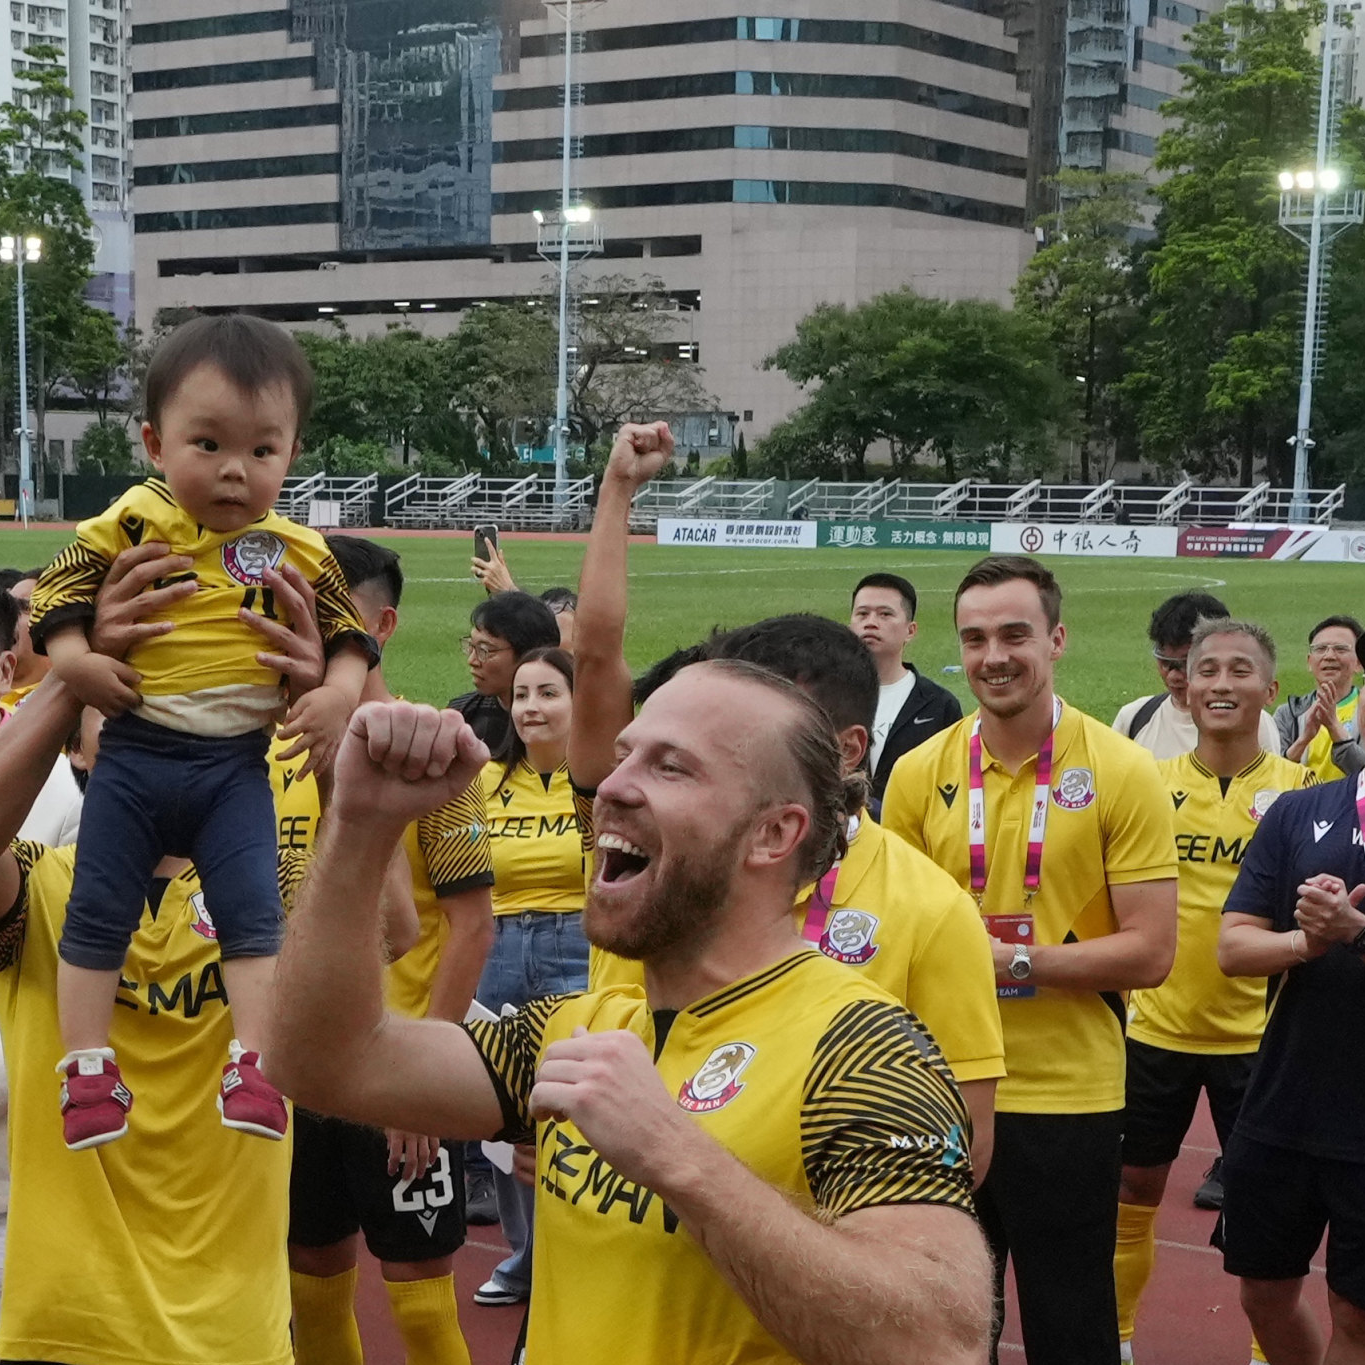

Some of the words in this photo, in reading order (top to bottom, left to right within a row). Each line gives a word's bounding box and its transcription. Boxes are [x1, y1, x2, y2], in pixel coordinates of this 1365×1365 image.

[673, 526, 716, 543] ATACAR
[725, 536, 800, 545] www.atacar.com.hk
[827, 525, 878, 547] 運動家
[226, 562, 242, 579] LEE
[1071, 801, 1087, 809] MAN
[278, 815, 311, 849] EE
[488, 817, 533, 838] LEE
[537, 817, 583, 838] MA
[1176, 834, 1211, 863] EE
[821, 945, 839, 960] LEE
[841, 954, 863, 963] MAN
[148, 962, 229, 1018] MA
[679, 1095, 695, 1110] LEE
[696, 1098, 721, 1111] MAN
[392, 1146, 454, 1214] 23
